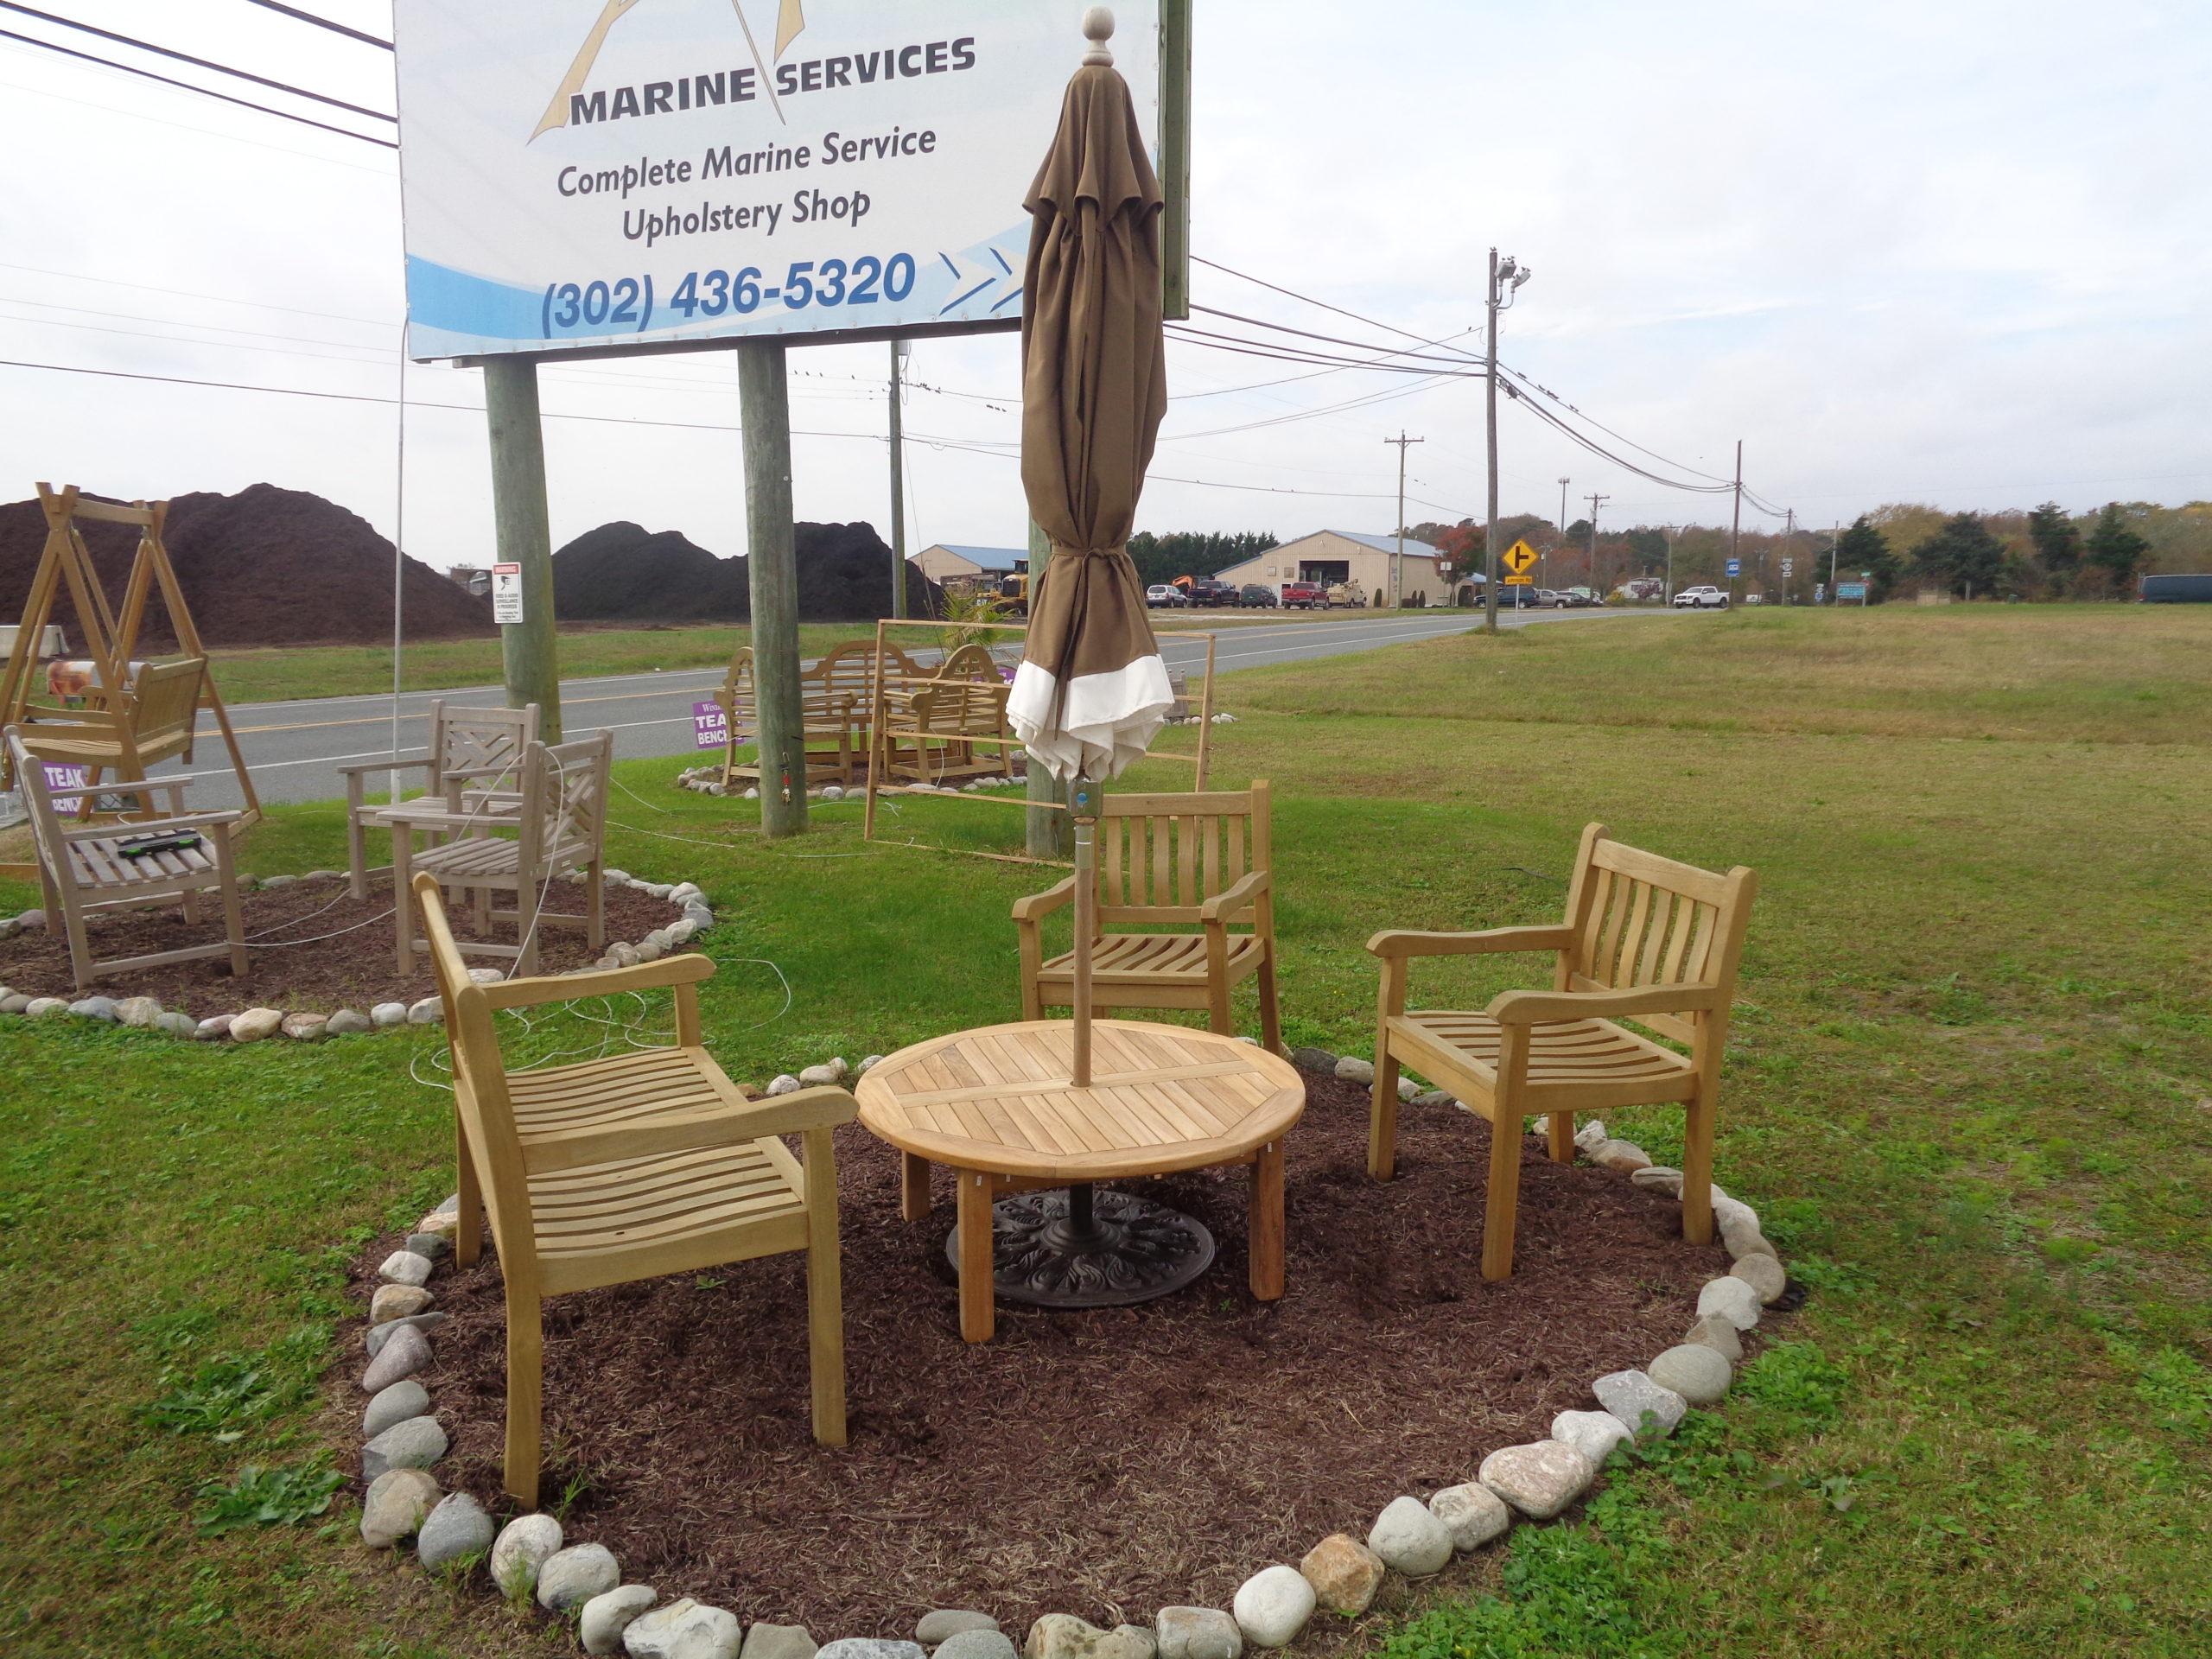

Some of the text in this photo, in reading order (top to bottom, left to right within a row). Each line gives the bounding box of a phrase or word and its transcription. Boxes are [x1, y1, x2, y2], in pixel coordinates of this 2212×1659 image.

[570, 36, 976, 126] MARINE SERVICES
[557, 126, 937, 199] Complete Marine Service
[622, 188, 871, 248] Upholstery Shop
[542, 252, 916, 340] (302) 436-5320
[696, 714, 726, 728] TEA
[44, 767, 86, 788] TEAK
